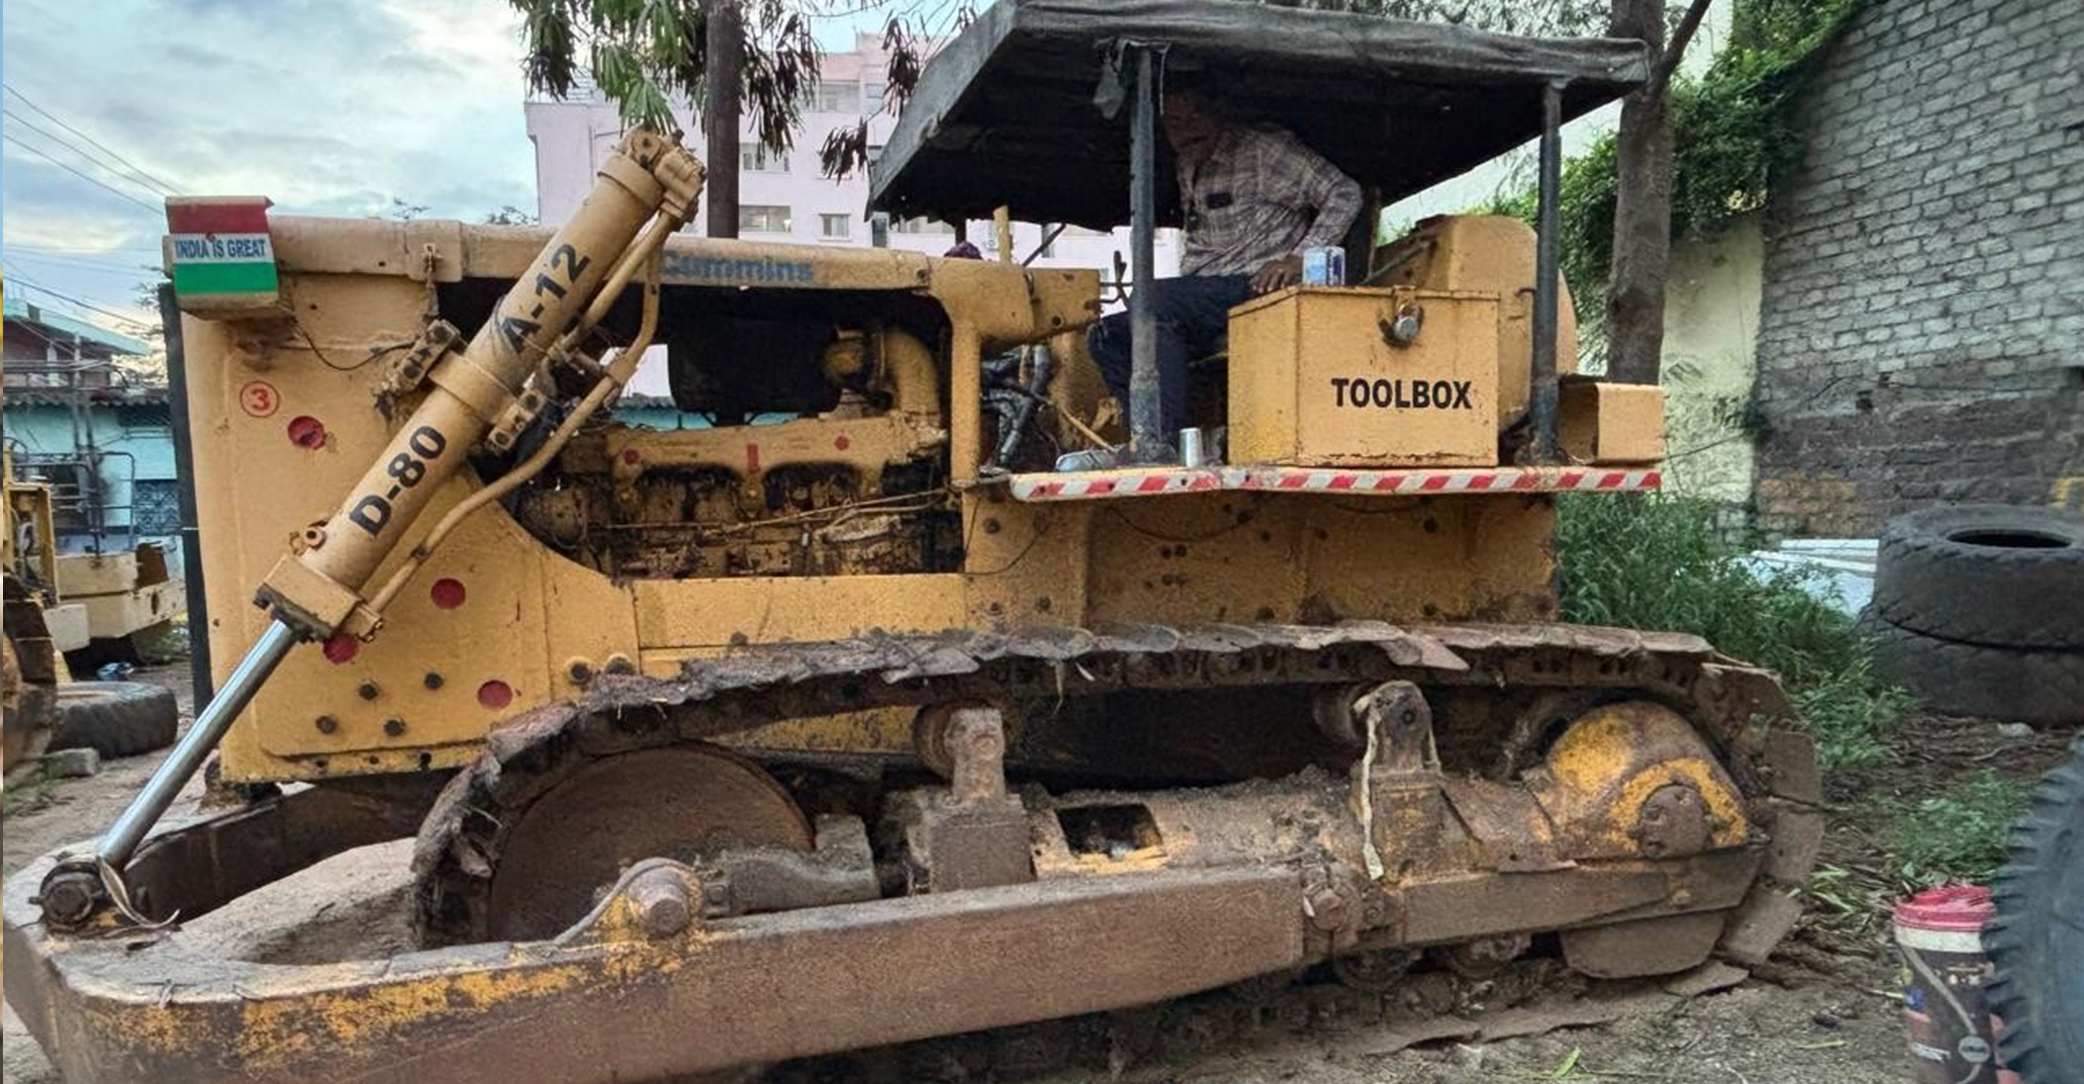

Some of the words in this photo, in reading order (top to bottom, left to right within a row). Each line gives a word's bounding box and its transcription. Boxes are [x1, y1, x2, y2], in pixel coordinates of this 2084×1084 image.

[175, 239, 210, 258] INDIA
[212, 239, 225, 258] IS
[227, 238, 265, 257] GREAT
[664, 250, 811, 282] Cummins
[501, 244, 591, 354] A-12
[251, 389, 270, 411] 3
[1331, 378, 1472, 410] TOOLBOX
[349, 426, 447, 532] D-80
